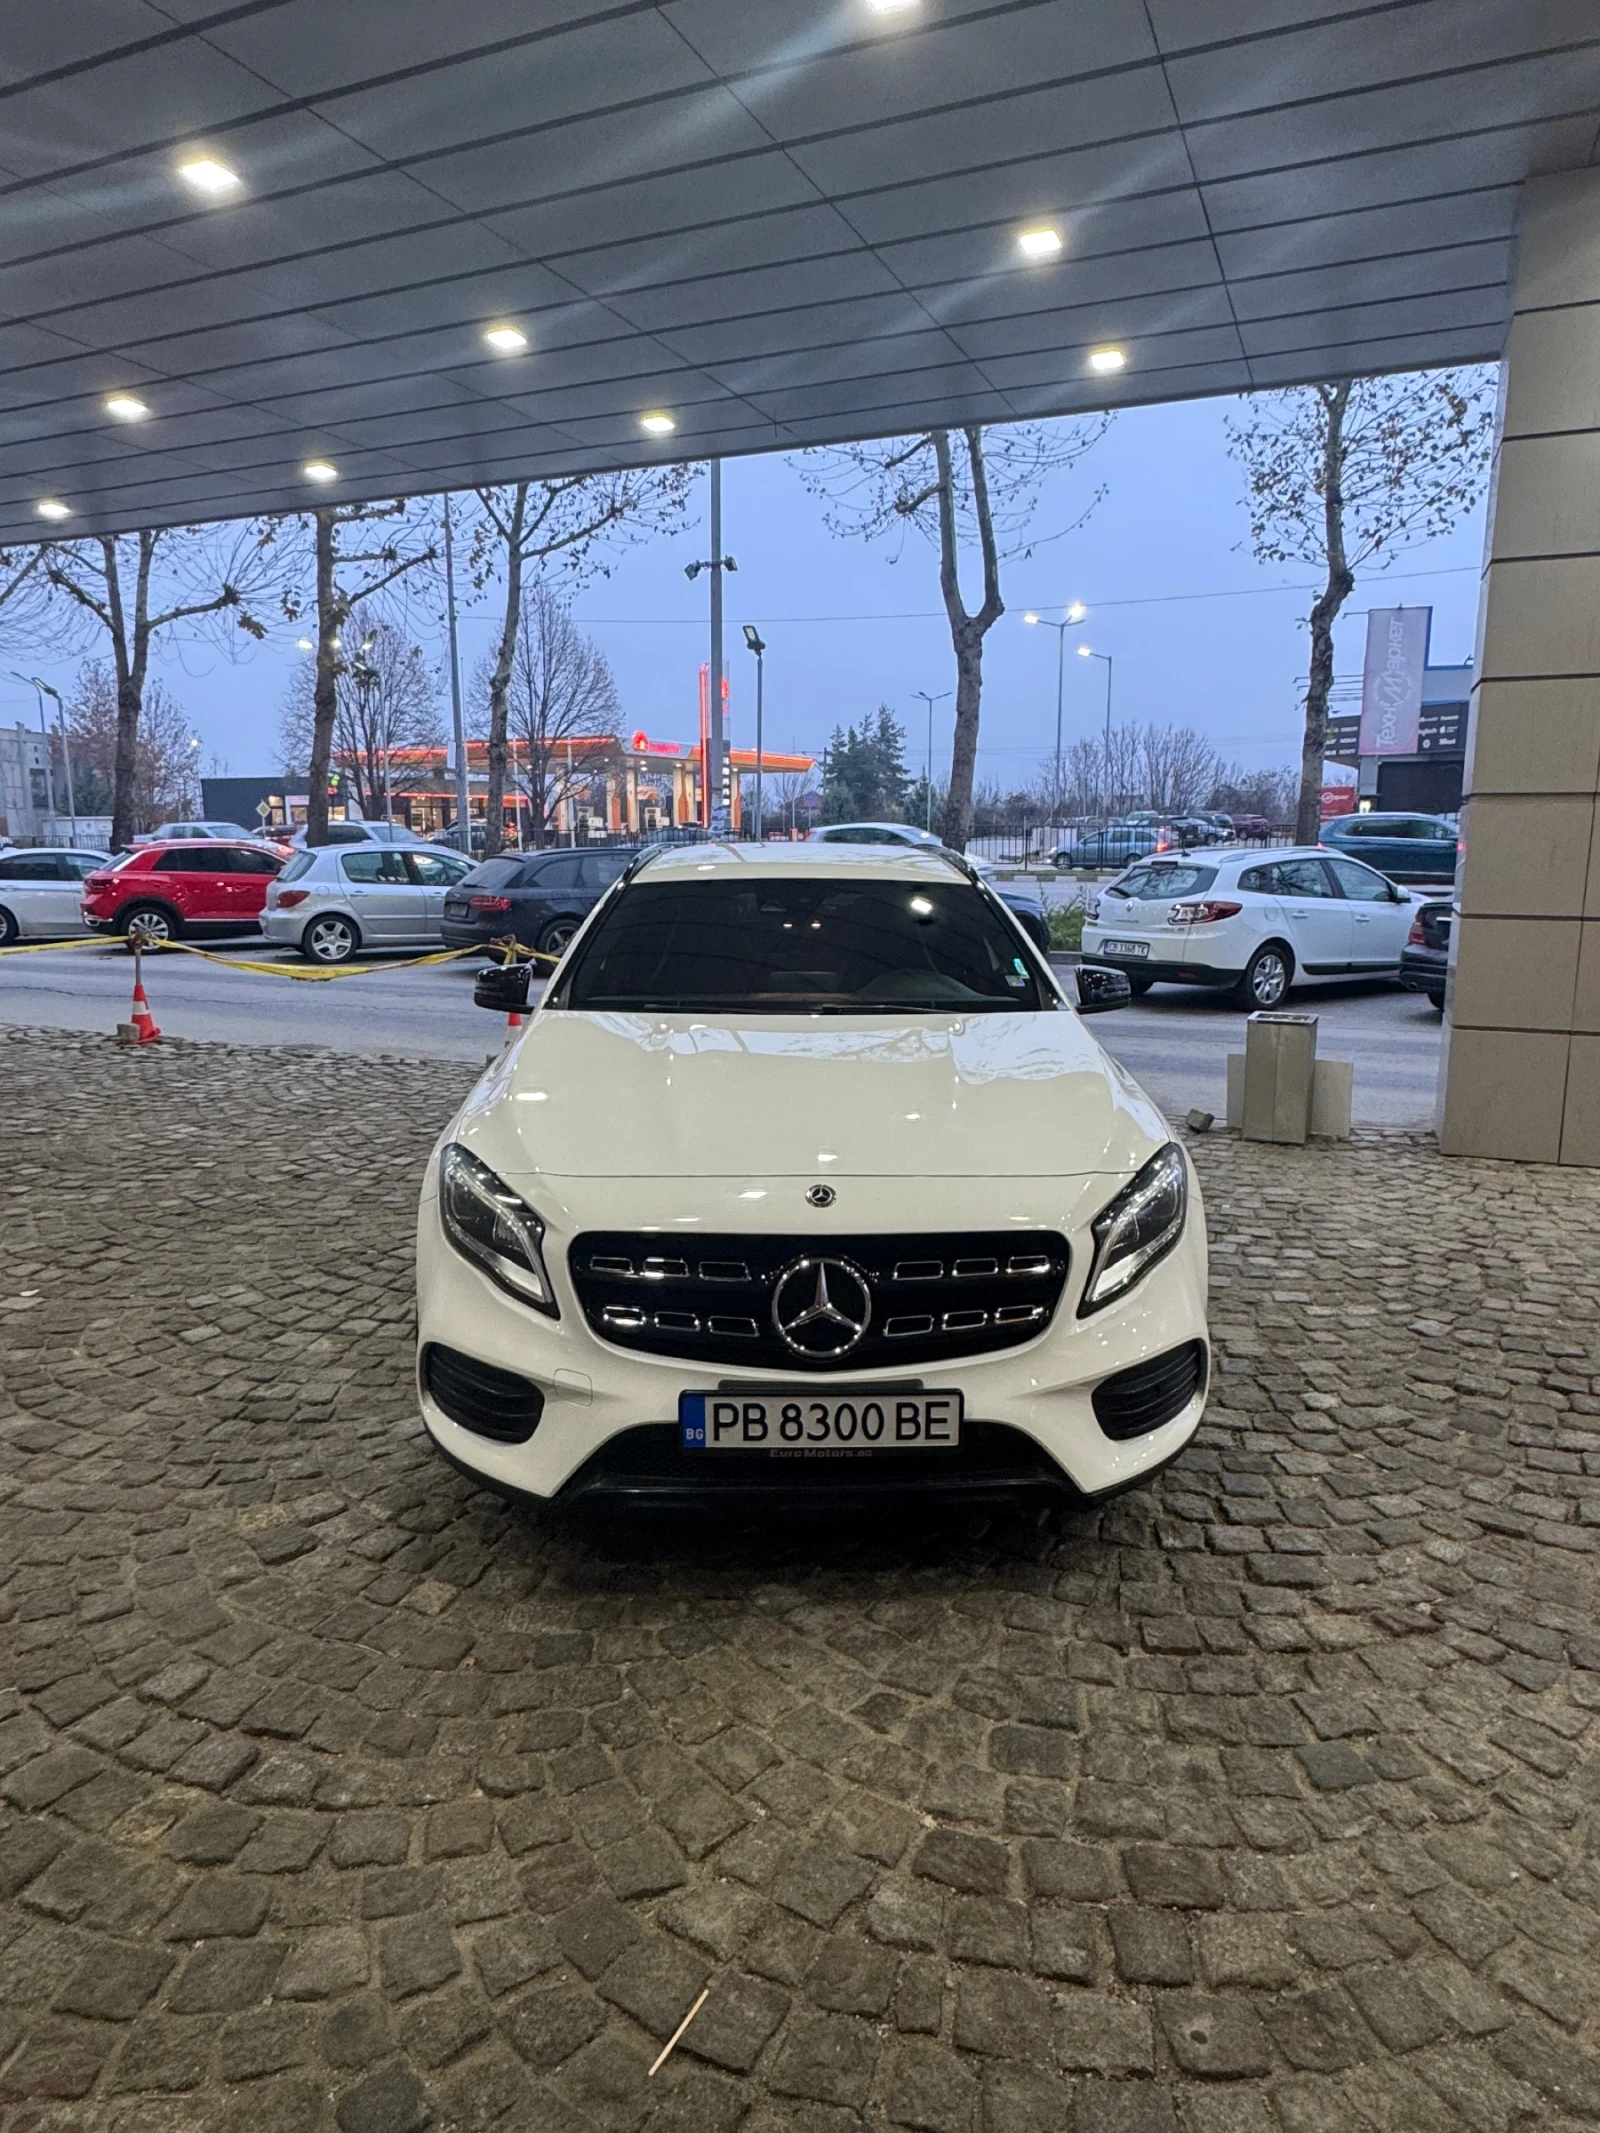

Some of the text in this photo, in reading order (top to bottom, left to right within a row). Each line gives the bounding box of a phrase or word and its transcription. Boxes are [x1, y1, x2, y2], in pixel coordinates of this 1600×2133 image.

[686, 1428, 704, 1440] BG
[713, 1401, 950, 1442] PB 8300 BE
